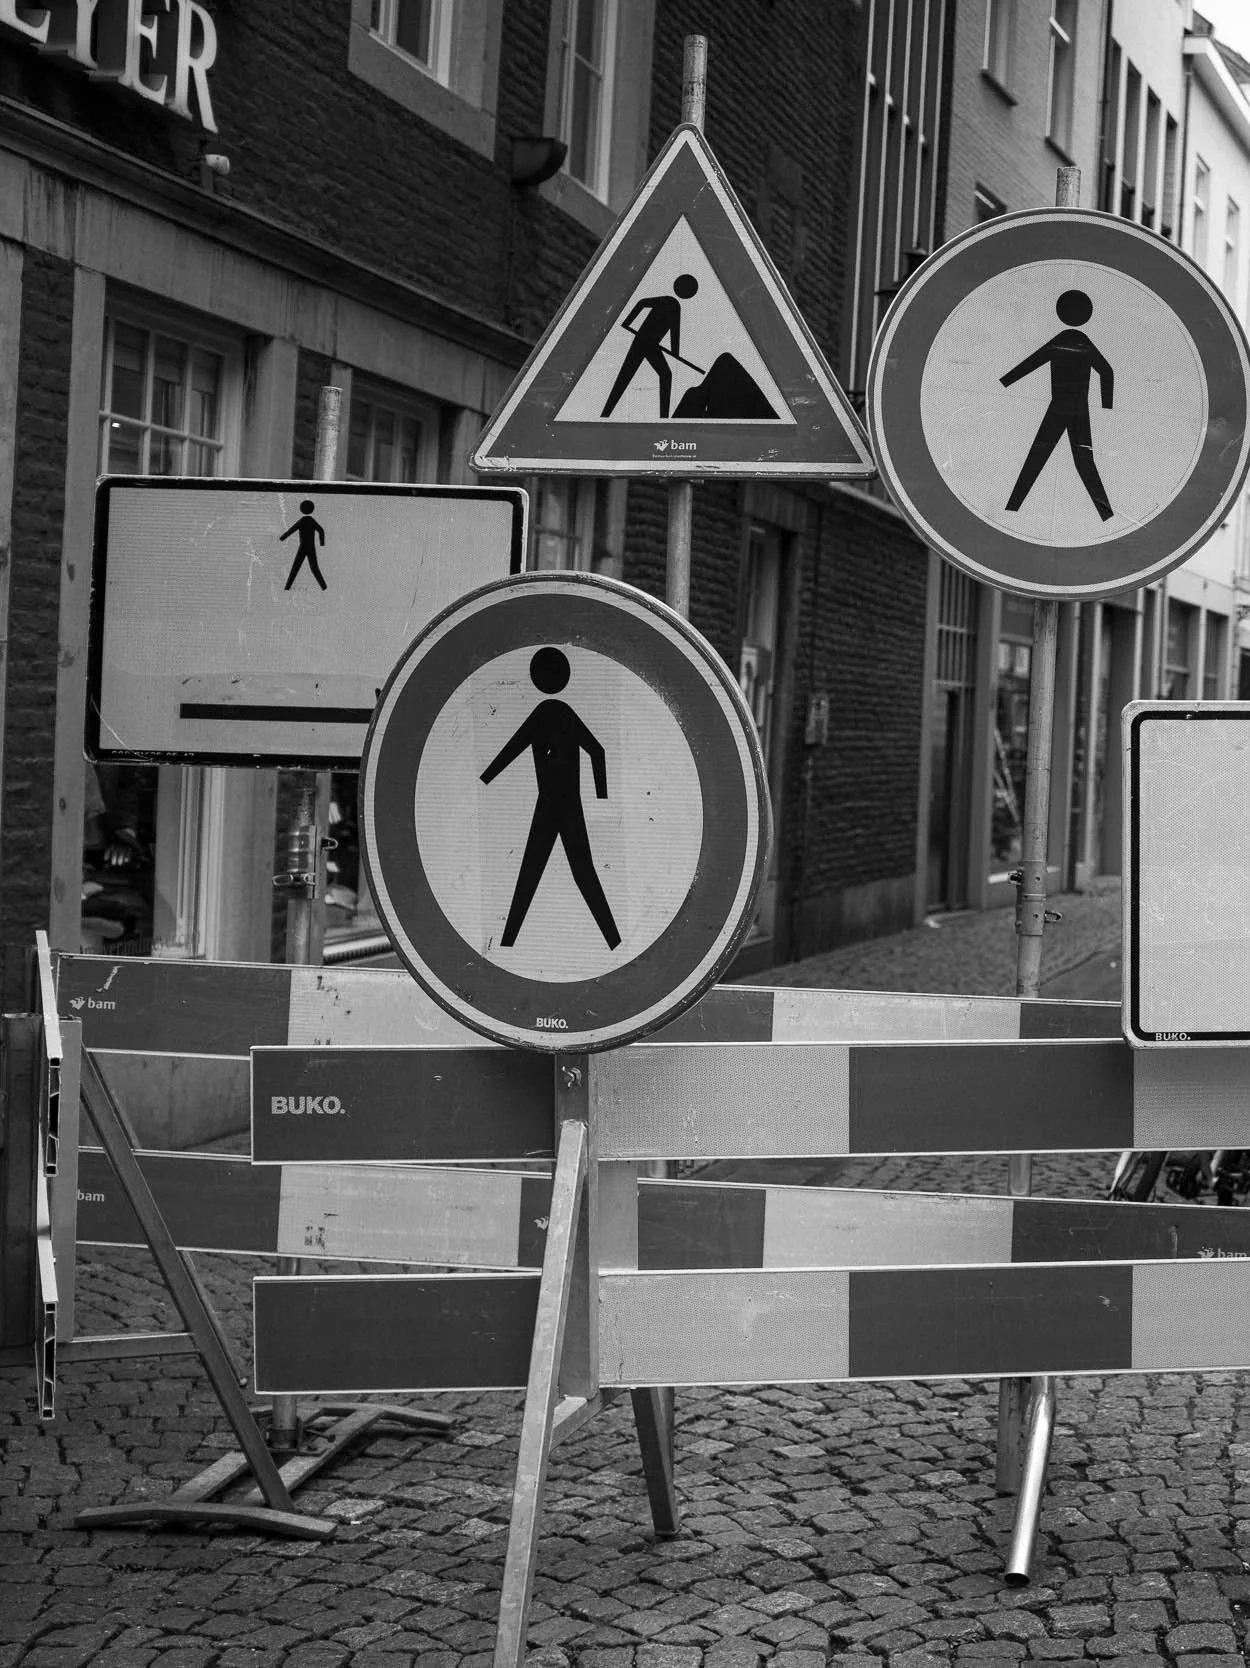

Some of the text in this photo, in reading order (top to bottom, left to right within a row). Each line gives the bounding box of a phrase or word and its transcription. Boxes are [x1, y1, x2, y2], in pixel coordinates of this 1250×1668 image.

[671, 439, 697, 450] bam
[87, 997, 116, 1010] bam
[536, 1017, 569, 1029] BUKO.
[1155, 1032, 1191, 1041] BUKO.
[271, 1095, 346, 1115] BUKO.
[77, 1189, 105, 1202] bam
[1218, 1247, 1248, 1259] bam
